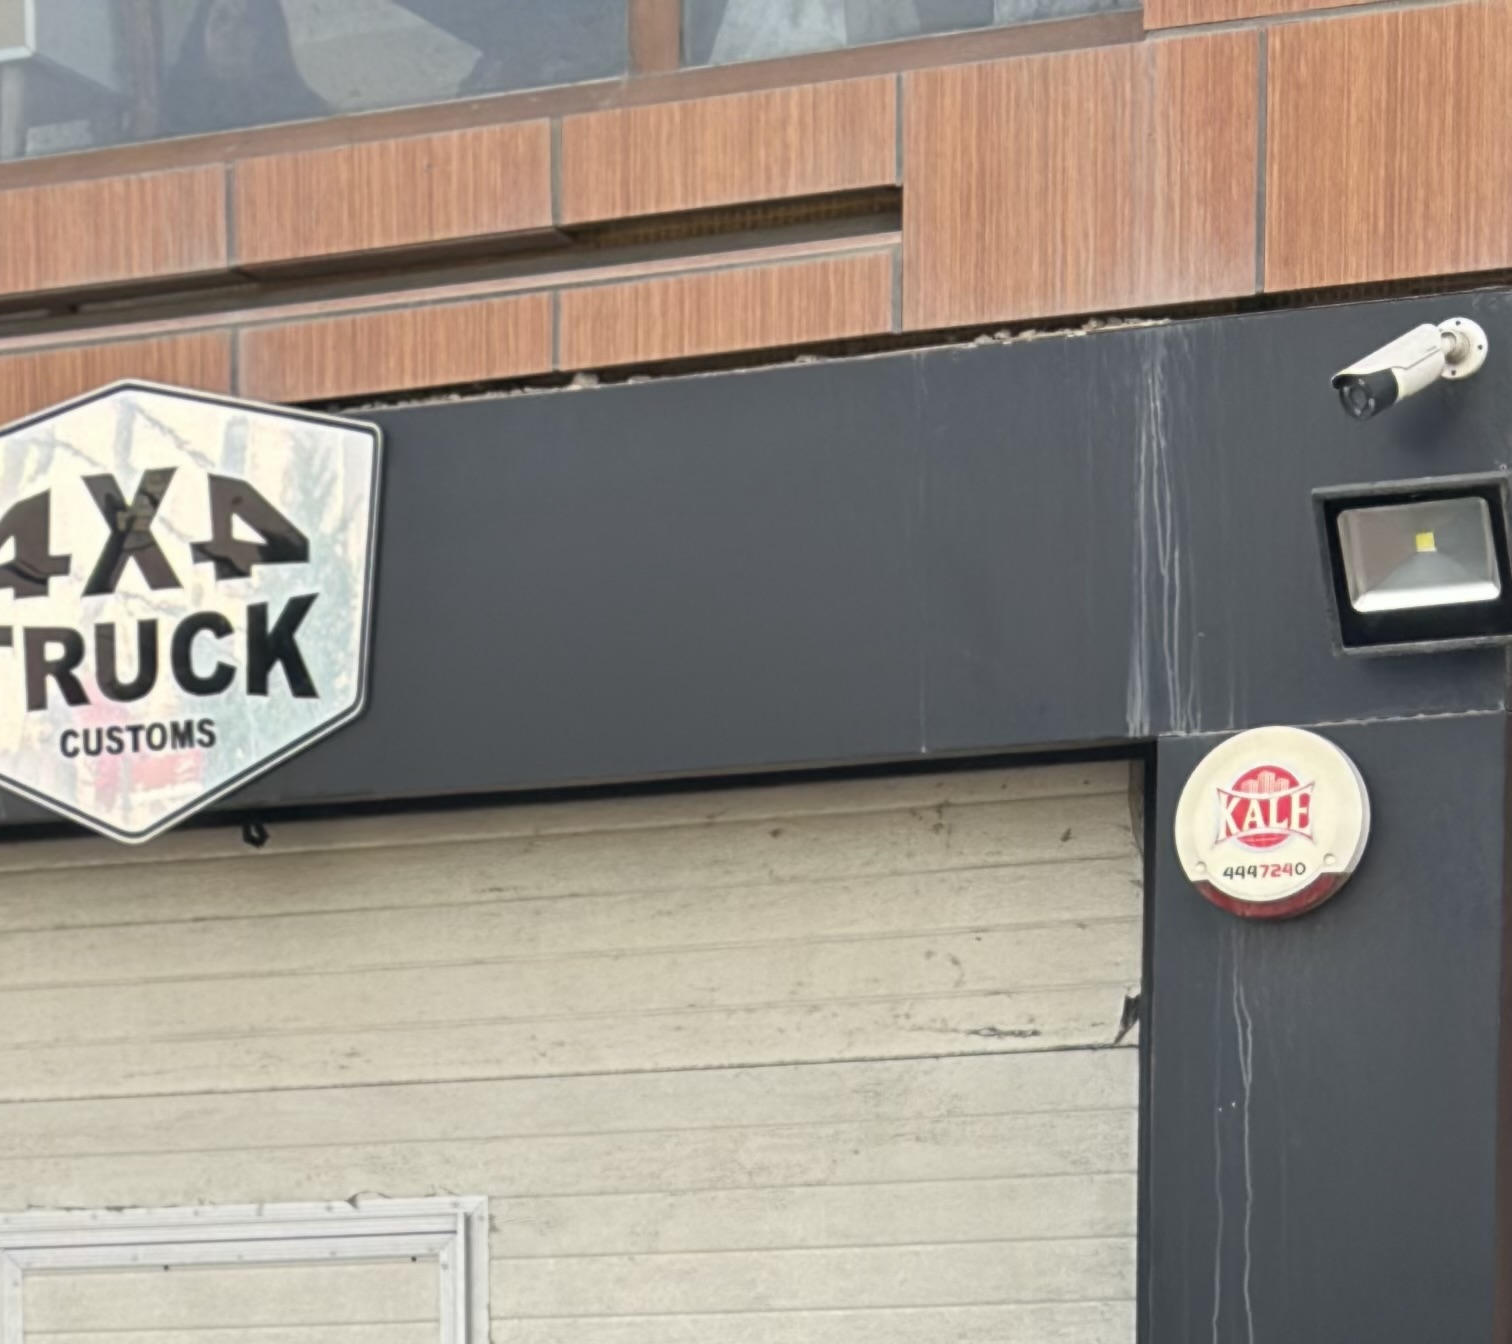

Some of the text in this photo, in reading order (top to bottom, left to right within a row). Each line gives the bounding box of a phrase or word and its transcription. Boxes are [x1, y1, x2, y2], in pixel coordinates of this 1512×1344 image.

[60, 718, 217, 758] CUSTOMS
[1215, 781, 1315, 845] KALE
[1223, 863, 1307, 880] 4447240
